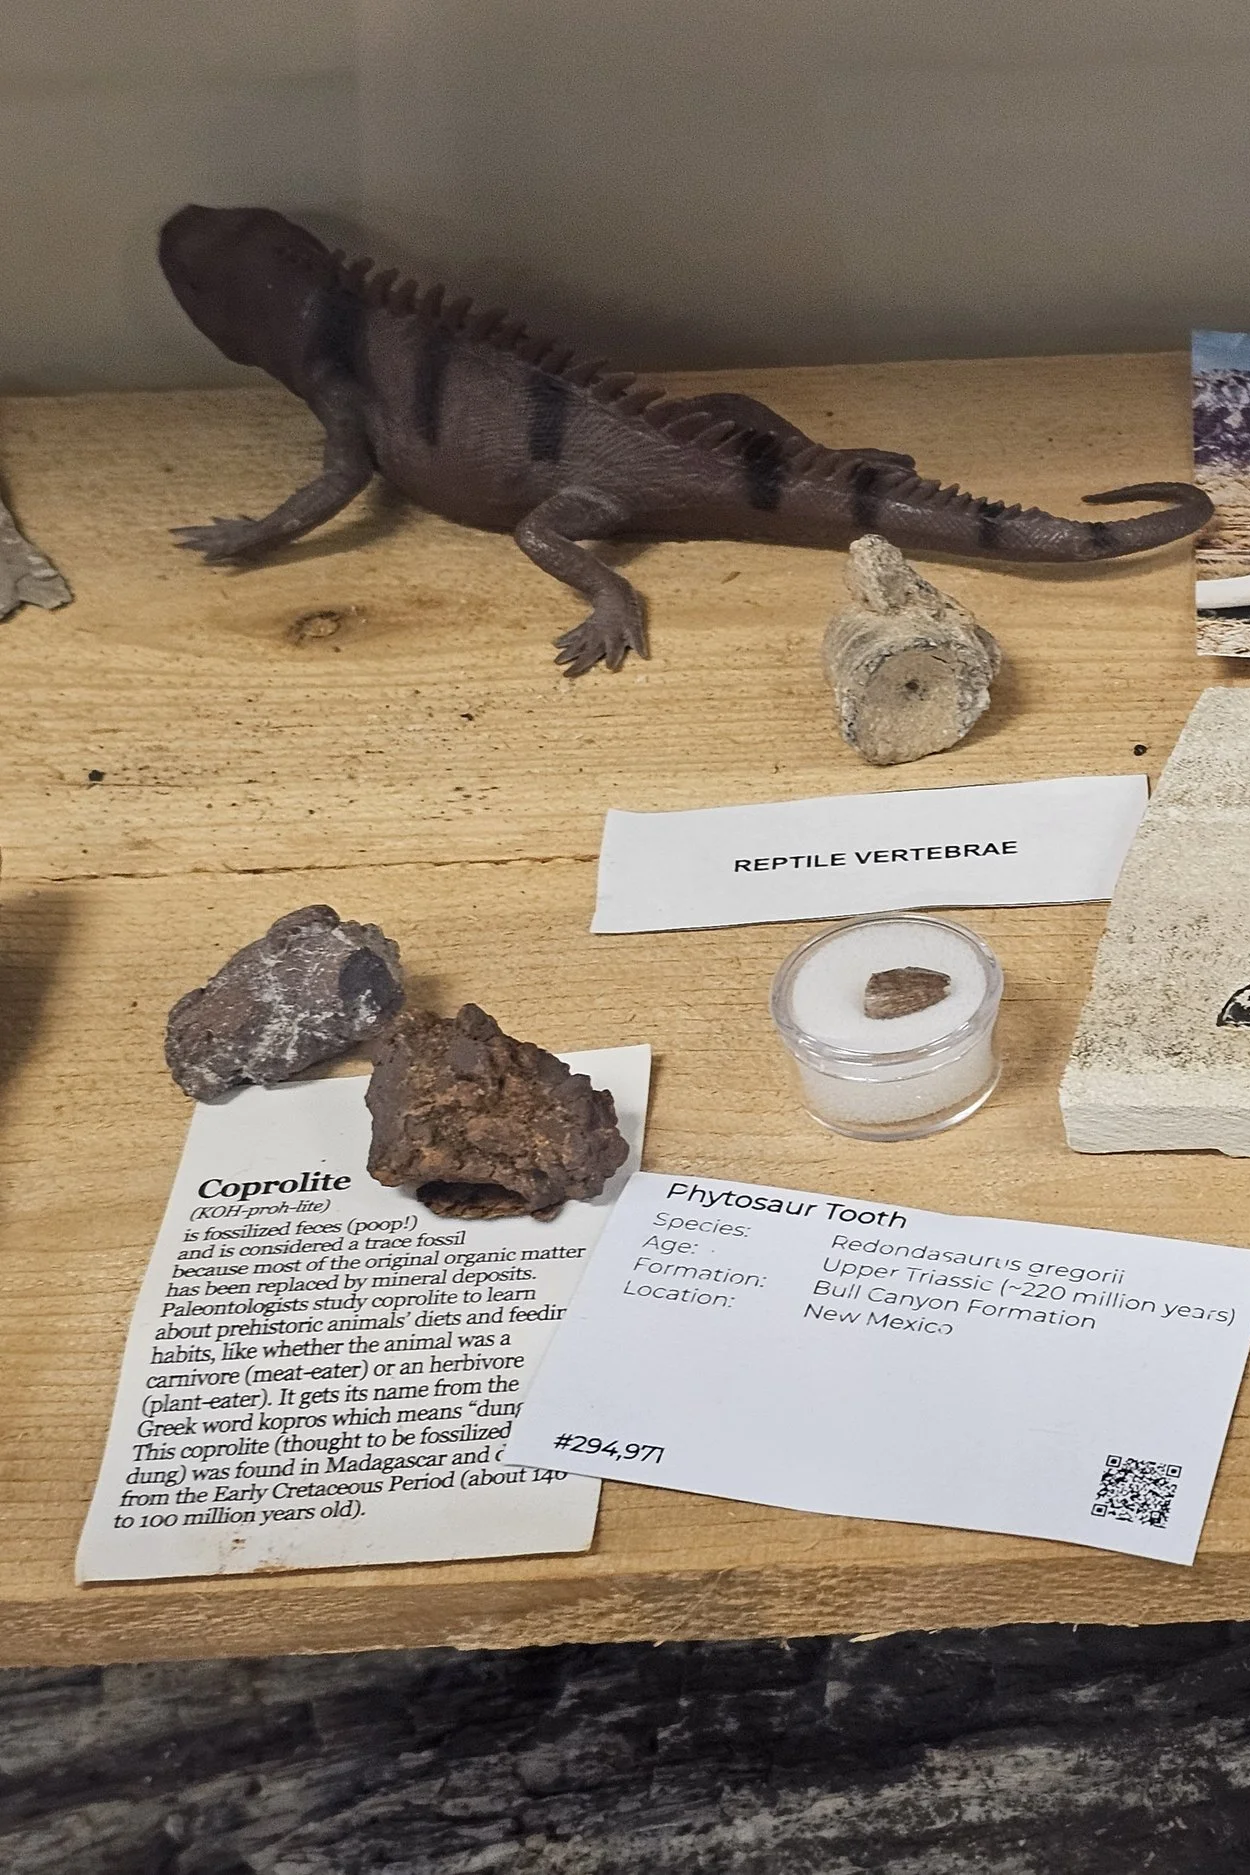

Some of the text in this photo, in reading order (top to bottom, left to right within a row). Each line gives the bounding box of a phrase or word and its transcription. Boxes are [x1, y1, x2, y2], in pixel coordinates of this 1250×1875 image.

[734, 841, 1018, 872] REPTILE VERTEBRAE
[198, 1171, 351, 1201] Coprolite
[190, 1199, 331, 1222] (KOH-proh-lite)
[667, 1182, 907, 1229] Phytosaur Tooth
[177, 1231, 466, 1260] and is considered a trace fossil
[182, 1215, 418, 1242] is fossilized feces (poop!)
[172, 1246, 586, 1278] because most of the original organic matter
[653, 1212, 1125, 1284] Species: Redondasaurus gregorii
[164, 1266, 536, 1299] has been replaced by mineral deposits.
[633, 1257, 1096, 1329] Formation: Bull Canyon Formation
[642, 1235, 1236, 1327] Age: Upper Triassic (~220 million years)
[160, 1286, 536, 1317] Paleontologists study coprolite to learn
[623, 1280, 953, 1335] Location: New Mexico
[155, 1323, 214, 1340] about
[214, 1316, 324, 1342] prehistoric
[414, 1310, 462, 1327] diets
[466, 1306, 504, 1325] and
[149, 1332, 511, 1367] habits, like whether the animal was a
[146, 1353, 524, 1389] carnivore (meat-eater) or an herbivore
[142, 1376, 519, 1418] (plant-eater). It gets its name from the
[137, 1418, 198, 1438] Greek
[201, 1414, 254, 1434] word
[256, 1413, 328, 1434] kopros
[332, 1406, 391, 1426] which
[395, 1407, 463, 1424] means
[132, 1422, 512, 1463] This coprolite (thought to be fossilized
[553, 1433, 665, 1464] #294,971
[126, 1465, 187, 1488] dung)
[191, 1467, 231, 1481] was
[233, 1458, 296, 1479] found
[298, 1457, 320, 1475] in
[323, 1450, 450, 1476] Madagascar
[451, 1446, 490, 1465] and
[119, 1490, 170, 1507] from
[175, 1487, 208, 1504] the
[211, 1483, 270, 1504] Early
[271, 1476, 385, 1499] Cretaceous
[388, 1470, 455, 1492] Period
[460, 1466, 530, 1490] (about
[114, 1500, 365, 1528] to 100 million years old).
